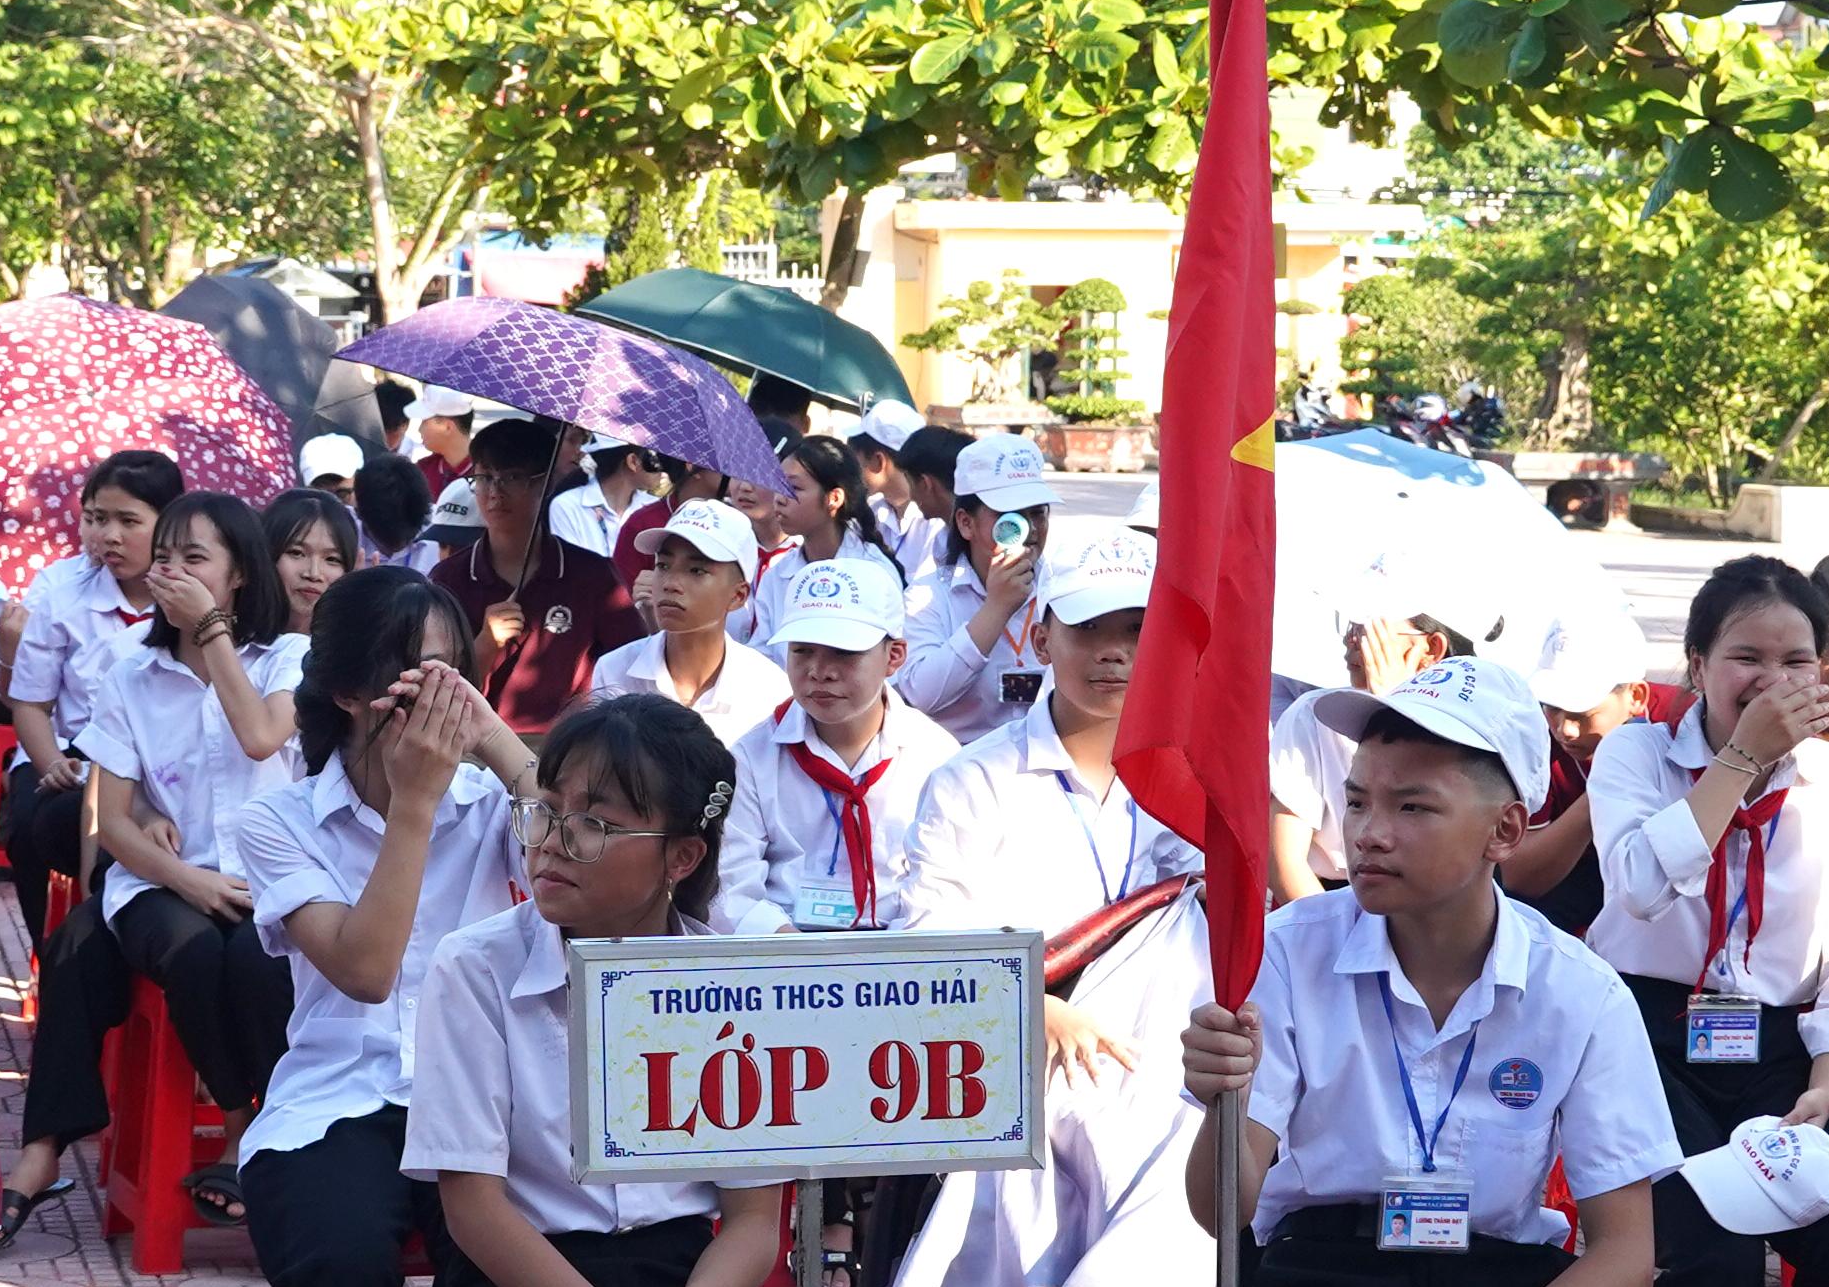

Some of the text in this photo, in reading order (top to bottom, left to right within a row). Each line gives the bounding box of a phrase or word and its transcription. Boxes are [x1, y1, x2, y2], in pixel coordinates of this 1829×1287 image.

[649, 967, 977, 1016] TRƯỜNG THCS GIAO HẢI
[639, 1020, 988, 1138] LỚP 9B
